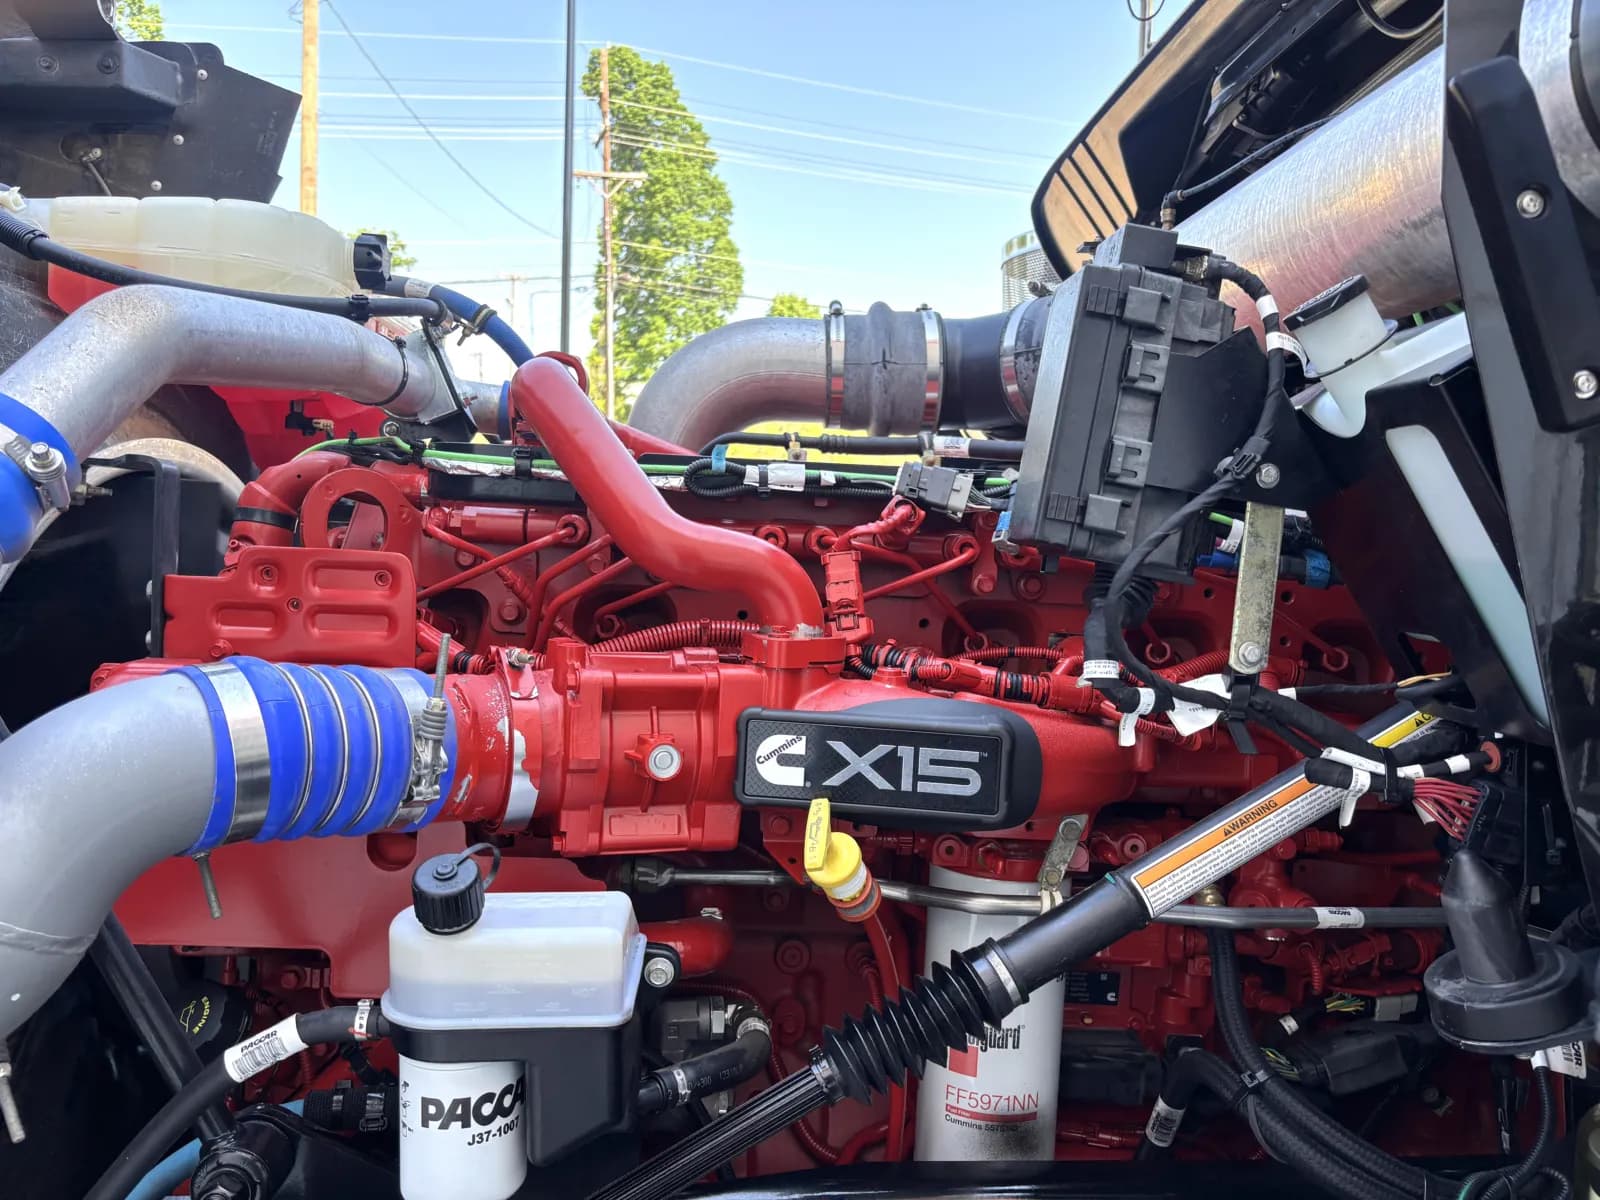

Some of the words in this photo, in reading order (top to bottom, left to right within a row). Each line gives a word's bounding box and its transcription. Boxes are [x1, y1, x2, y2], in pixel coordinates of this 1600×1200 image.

[756, 735, 803, 765] Cummins
[822, 740, 982, 797] X15
[1228, 798, 1277, 832] WARNING
[192, 996, 210, 1035] ENGINE
[240, 1030, 278, 1052] PACCAR
[421, 1075, 525, 1130] PACCA
[945, 1084, 1039, 1112] FF5971NN
[945, 1114, 983, 1130] Cummins
